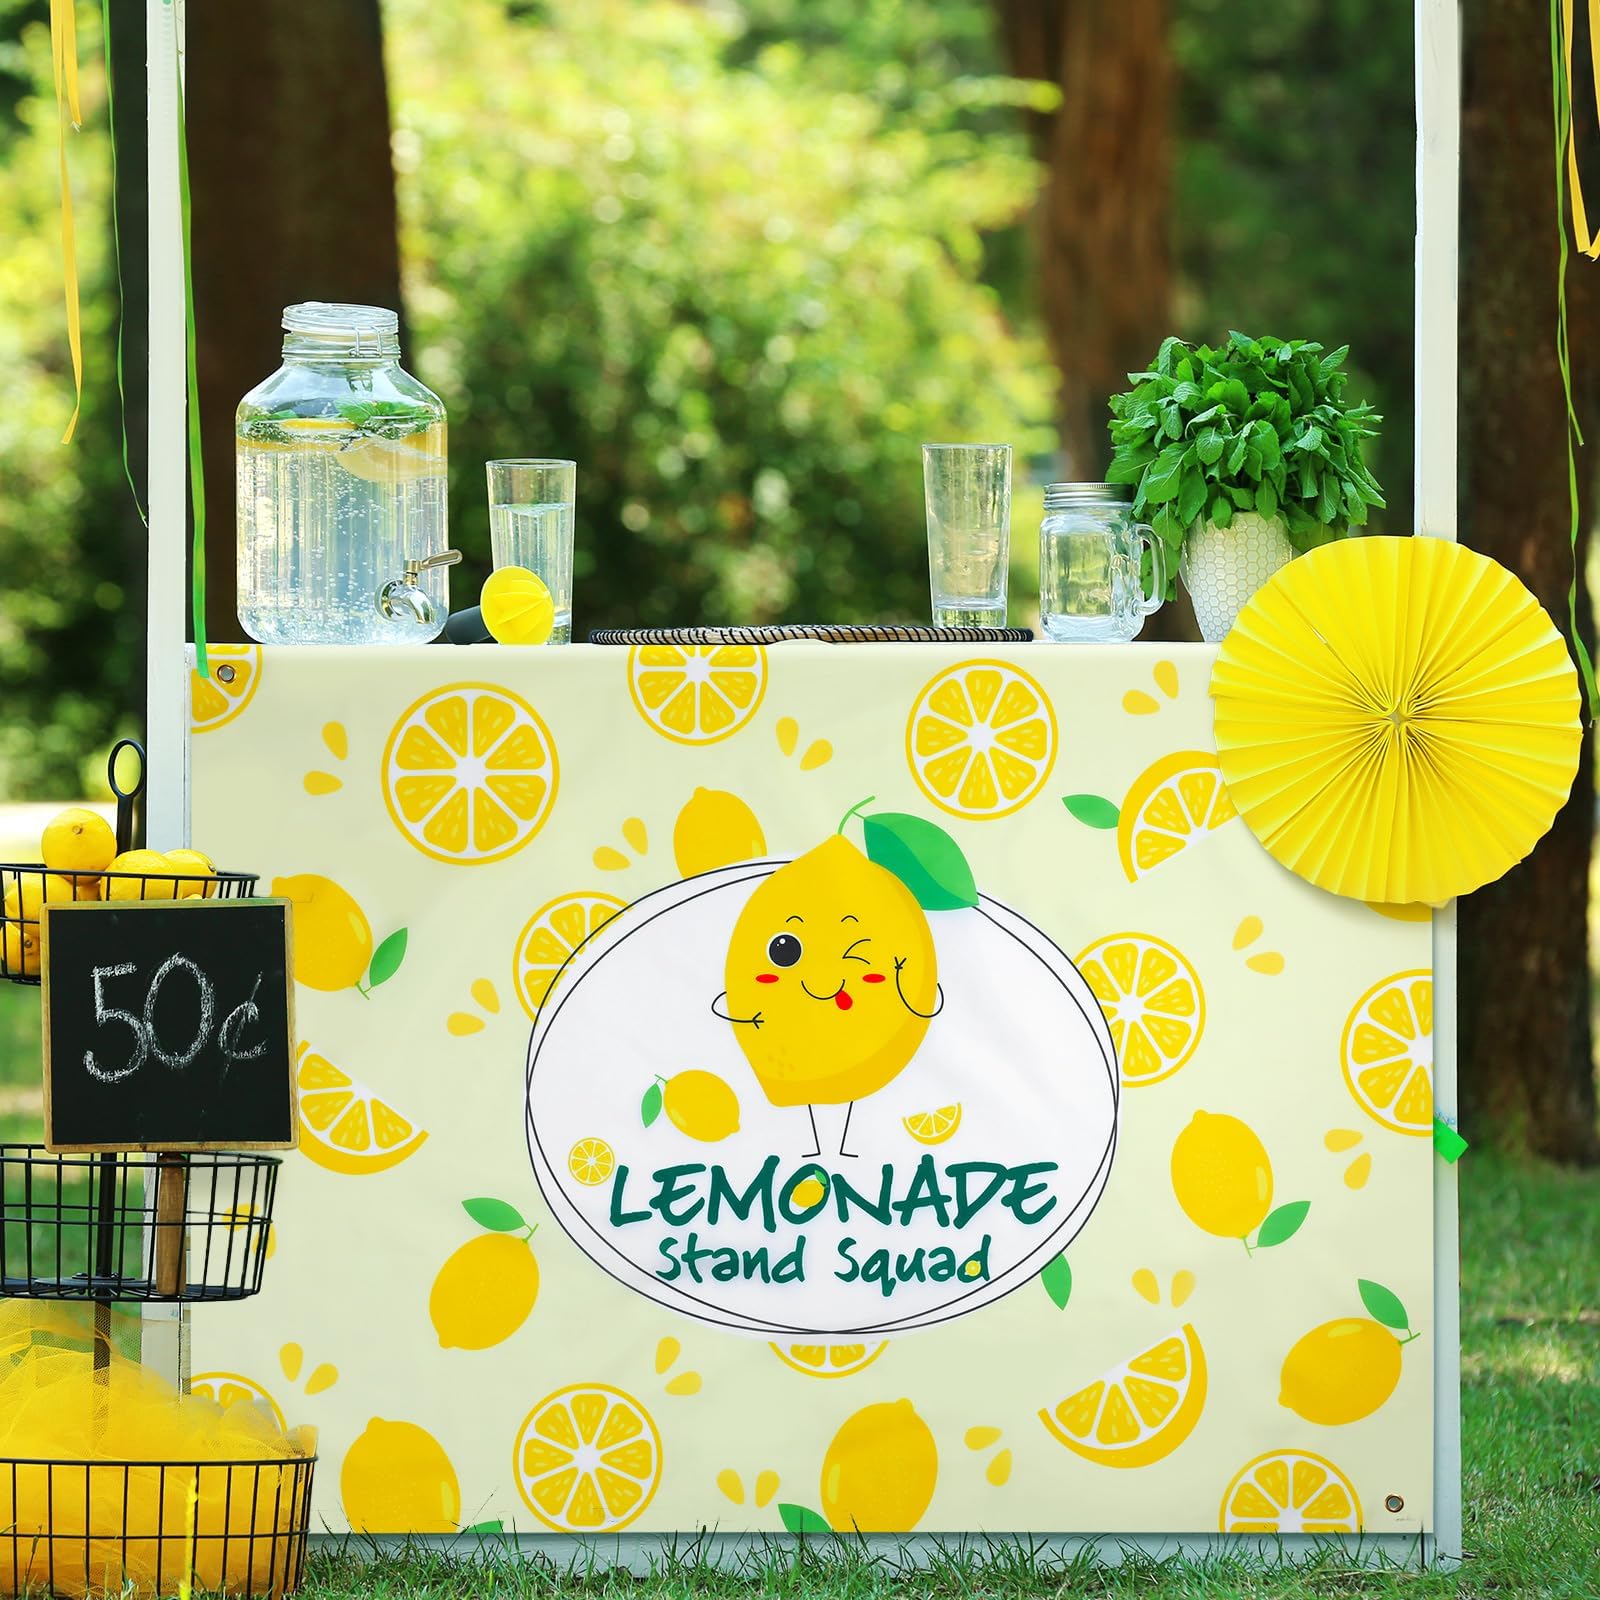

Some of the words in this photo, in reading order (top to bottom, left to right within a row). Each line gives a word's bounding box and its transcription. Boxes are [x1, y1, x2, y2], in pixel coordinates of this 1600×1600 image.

[83, 952, 268, 1087] 50¢
[609, 1154, 1058, 1233] LEMONADE
[655, 1232, 806, 1284] Stand
[833, 1233, 992, 1298] Squad
